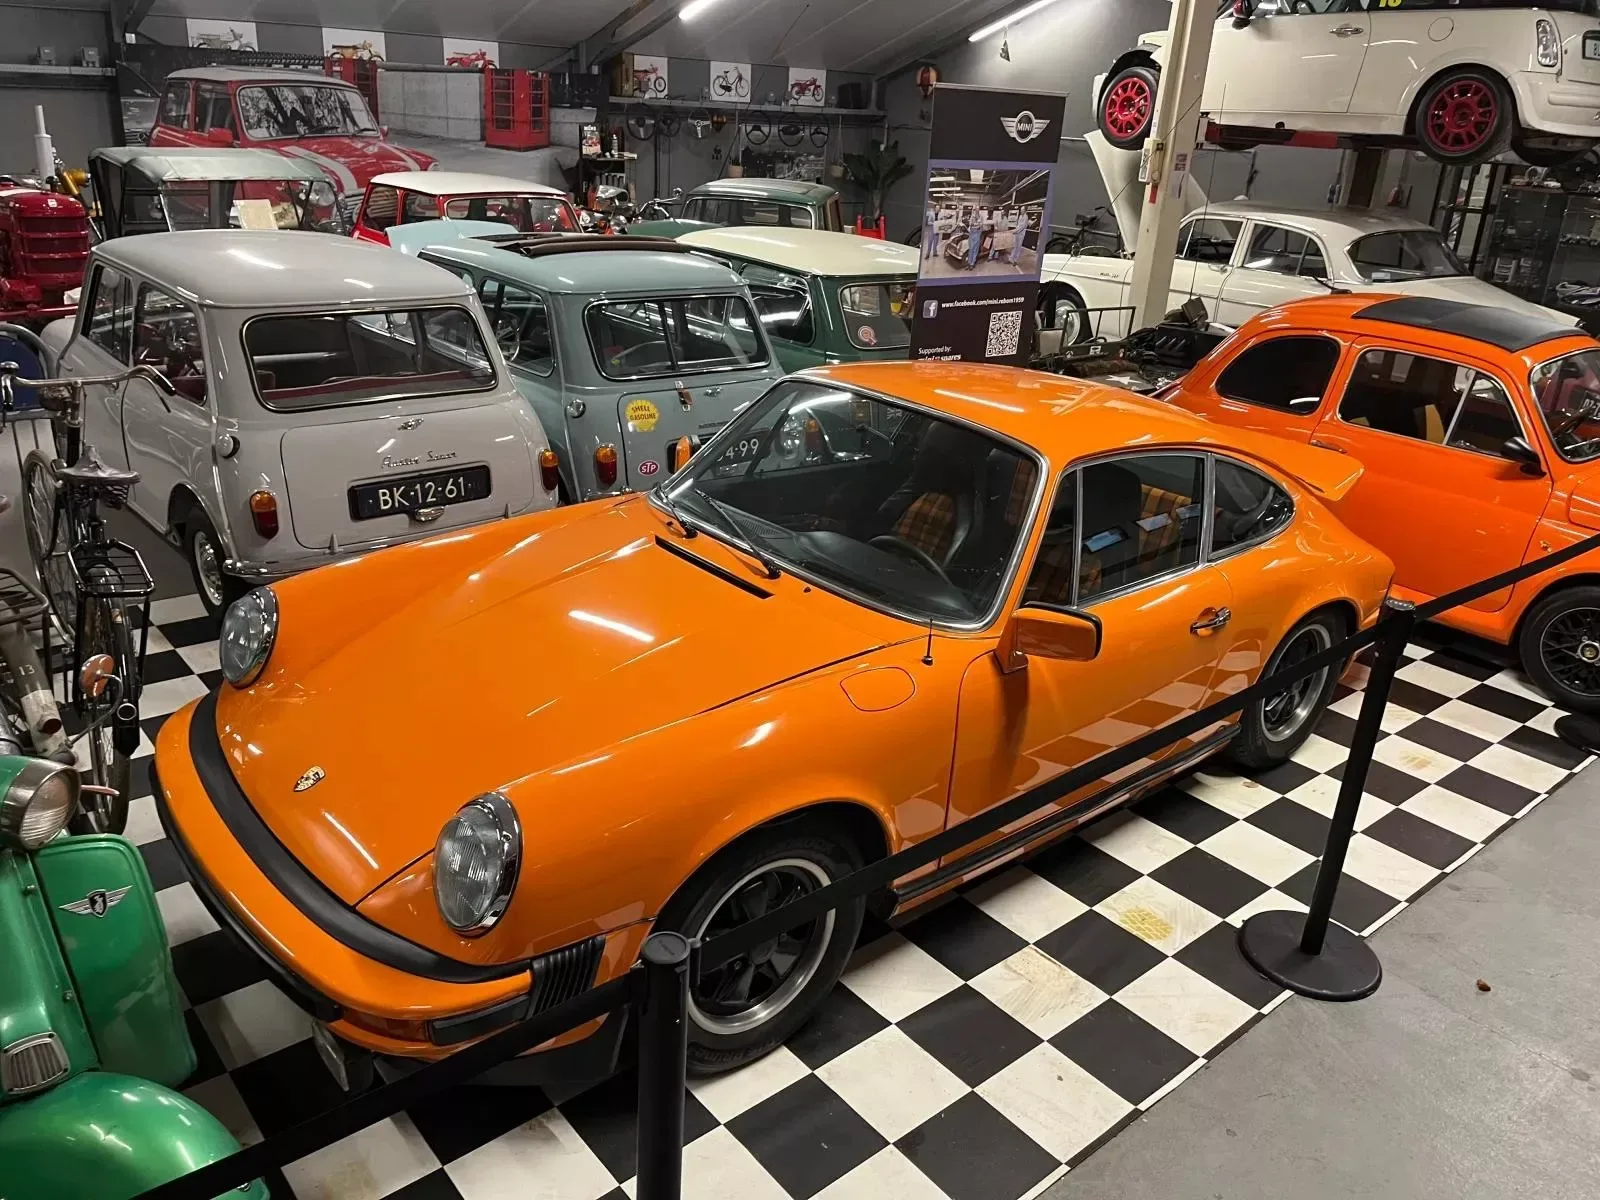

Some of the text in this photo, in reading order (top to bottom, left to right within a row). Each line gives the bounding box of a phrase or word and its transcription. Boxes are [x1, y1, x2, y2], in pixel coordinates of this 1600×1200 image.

[1017, 123, 1033, 131] MINI
[918, 346, 944, 355] Supported
[631, 404, 650, 412] SHELL
[629, 412, 657, 421] GASOLINE
[641, 461, 656, 474] STP
[378, 476, 466, 510] BK-12-61
[18, 664, 36, 676] 13
